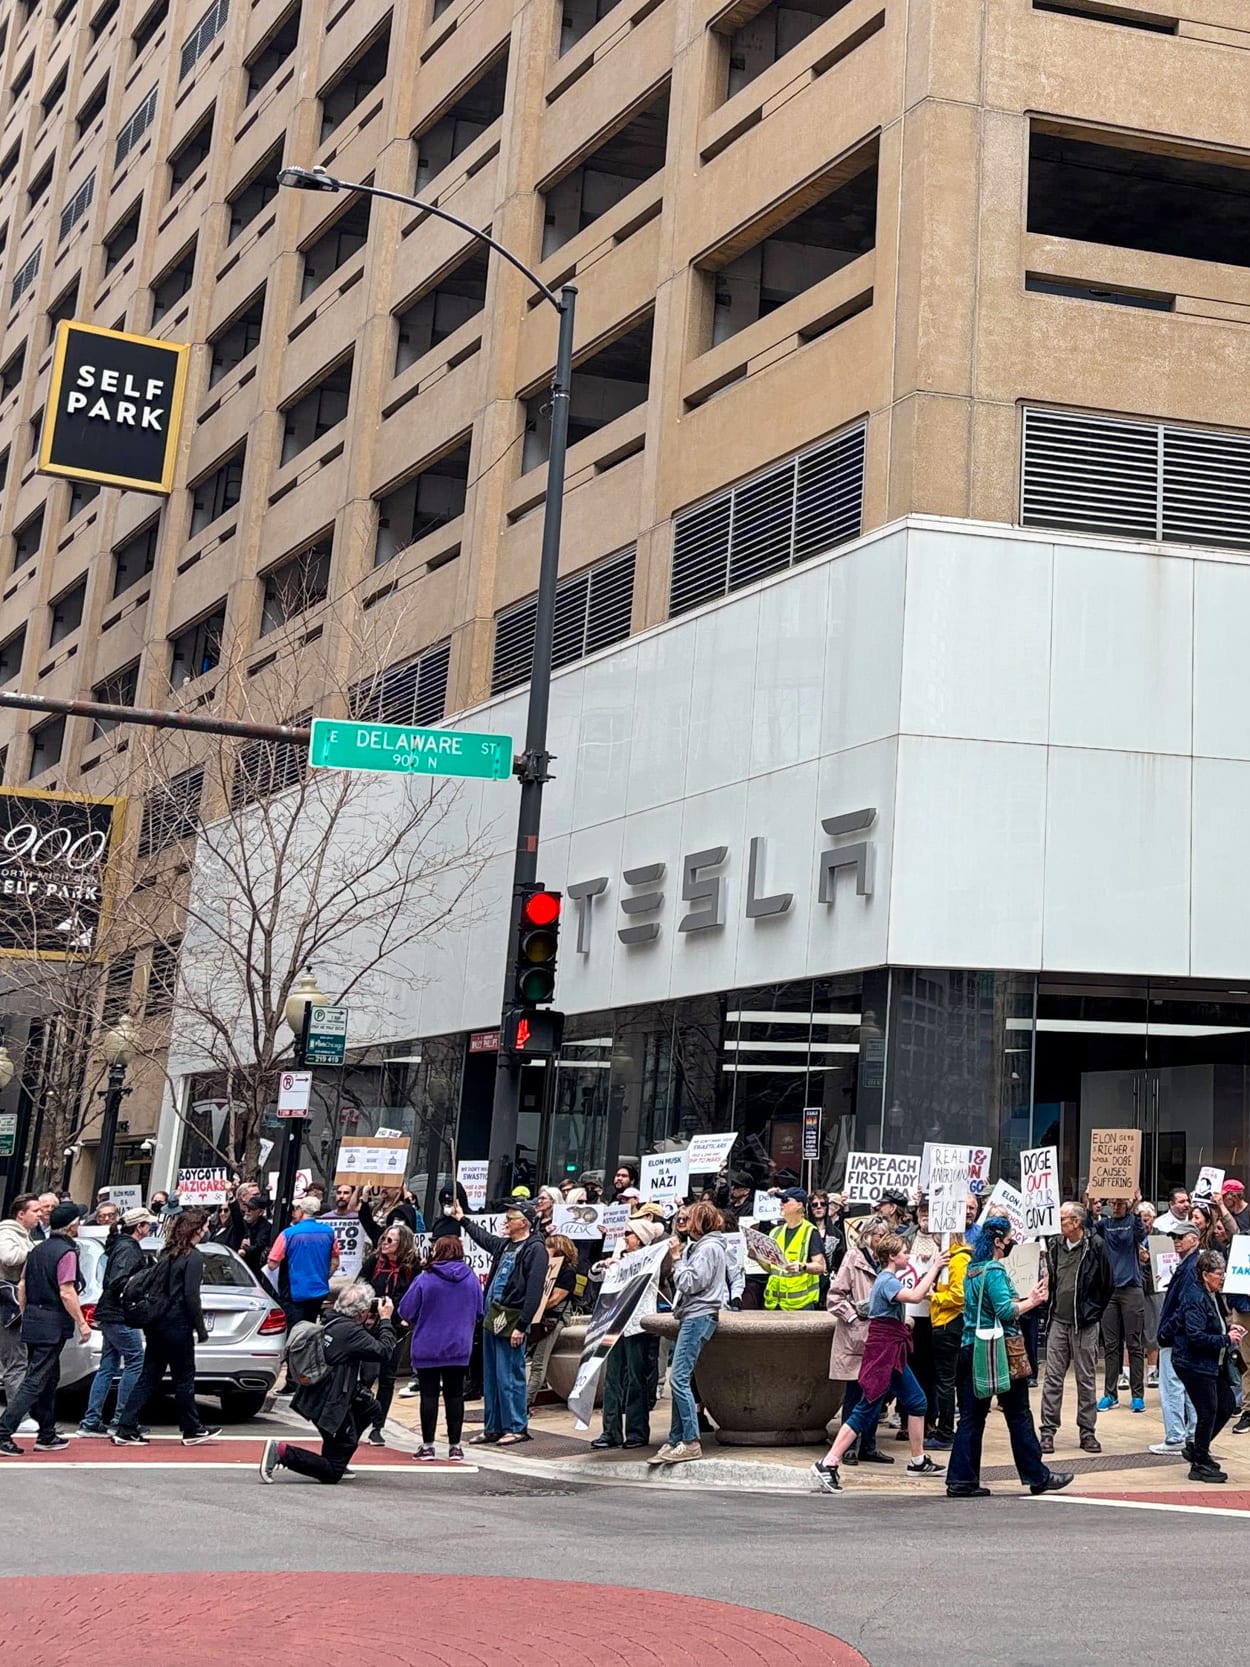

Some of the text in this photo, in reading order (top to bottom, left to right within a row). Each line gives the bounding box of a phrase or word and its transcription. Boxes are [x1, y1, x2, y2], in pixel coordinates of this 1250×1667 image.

[77, 365, 164, 400] SELF
[67, 391, 164, 431] PARK
[330, 730, 497, 755] E DELAWARE ST
[393, 755, 437, 769] 900 N
[0, 824, 105, 869] 900
[567, 807, 877, 953] TESLA
[47, 883, 98, 900] PARK
[1093, 1133, 1117, 1144] ELON
[936, 1148, 965, 1165] REAL
[1098, 1144, 1128, 1155] RICHER
[851, 1156, 917, 1173] IMPEACH
[1024, 1150, 1051, 1176] DOGE
[1097, 1166, 1127, 1176] CAUSES
[179, 1168, 226, 1182] BOYCOTT
[651, 1175, 677, 1189] NAZI
[848, 1171, 918, 1187] FIRST LADY
[1027, 1173, 1051, 1192] OUT
[1091, 1176, 1132, 1188] SUFFERING
[1002, 1190, 1019, 1205] ELON
[932, 1200, 965, 1216] FIGHT
[1026, 1206, 1054, 1229] GOVT
